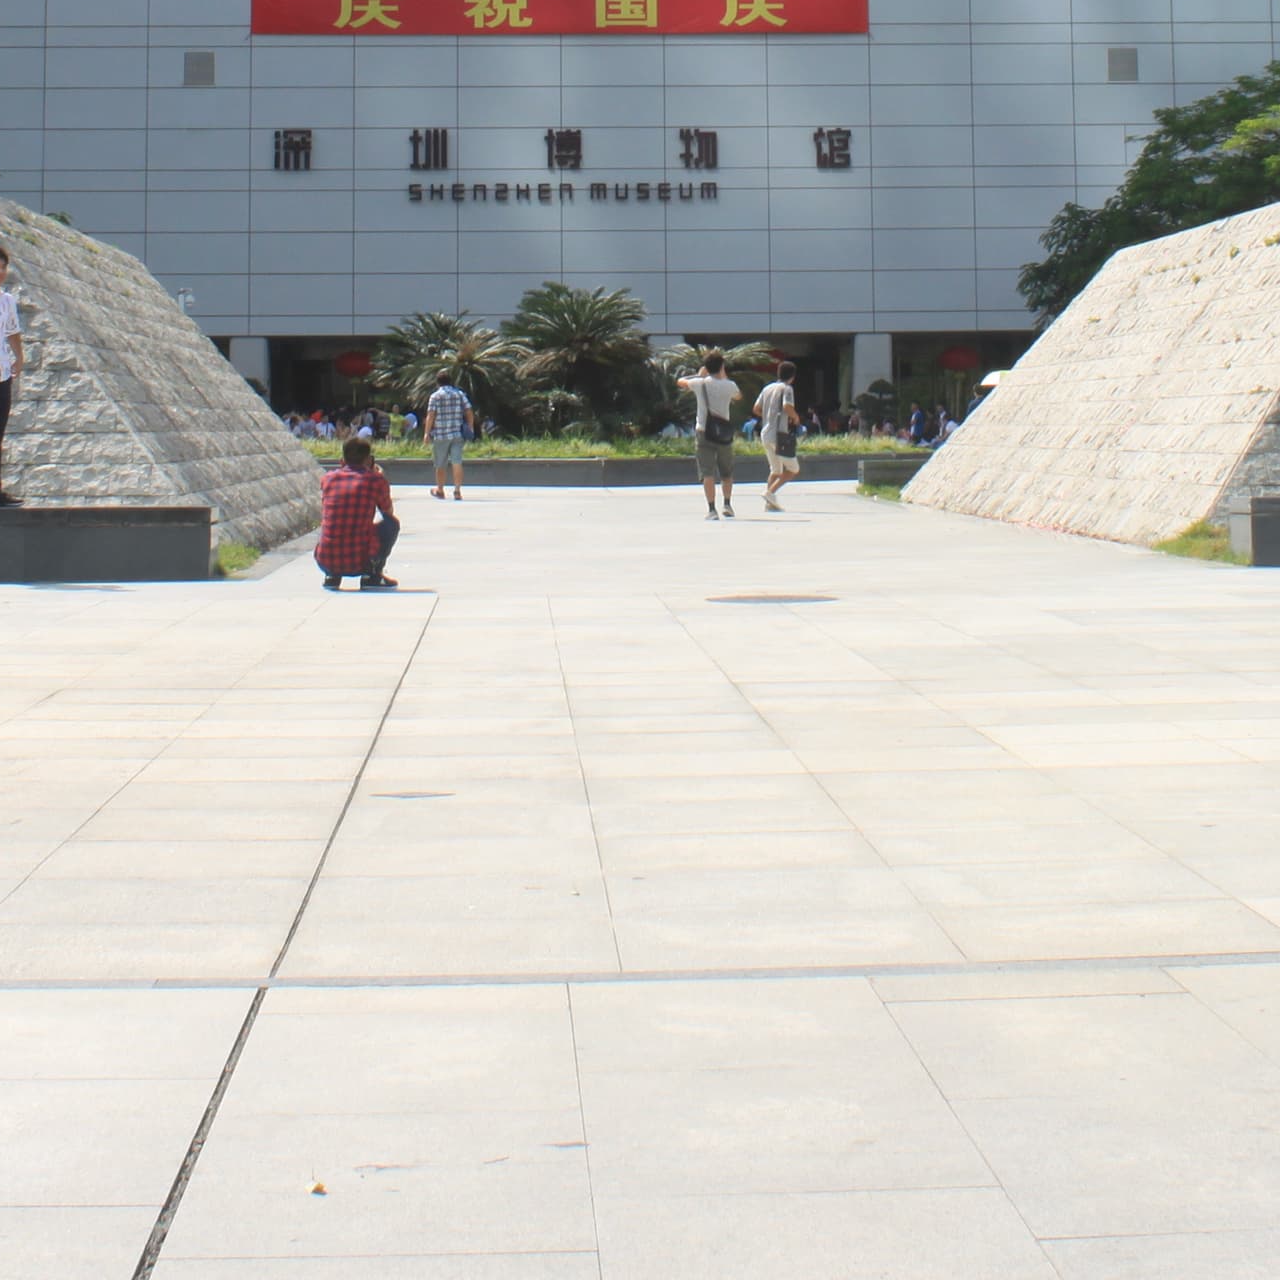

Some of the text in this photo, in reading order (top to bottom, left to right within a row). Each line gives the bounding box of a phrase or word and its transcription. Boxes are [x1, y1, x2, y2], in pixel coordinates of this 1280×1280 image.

[273, 127, 852, 170] 深圳博物馆
